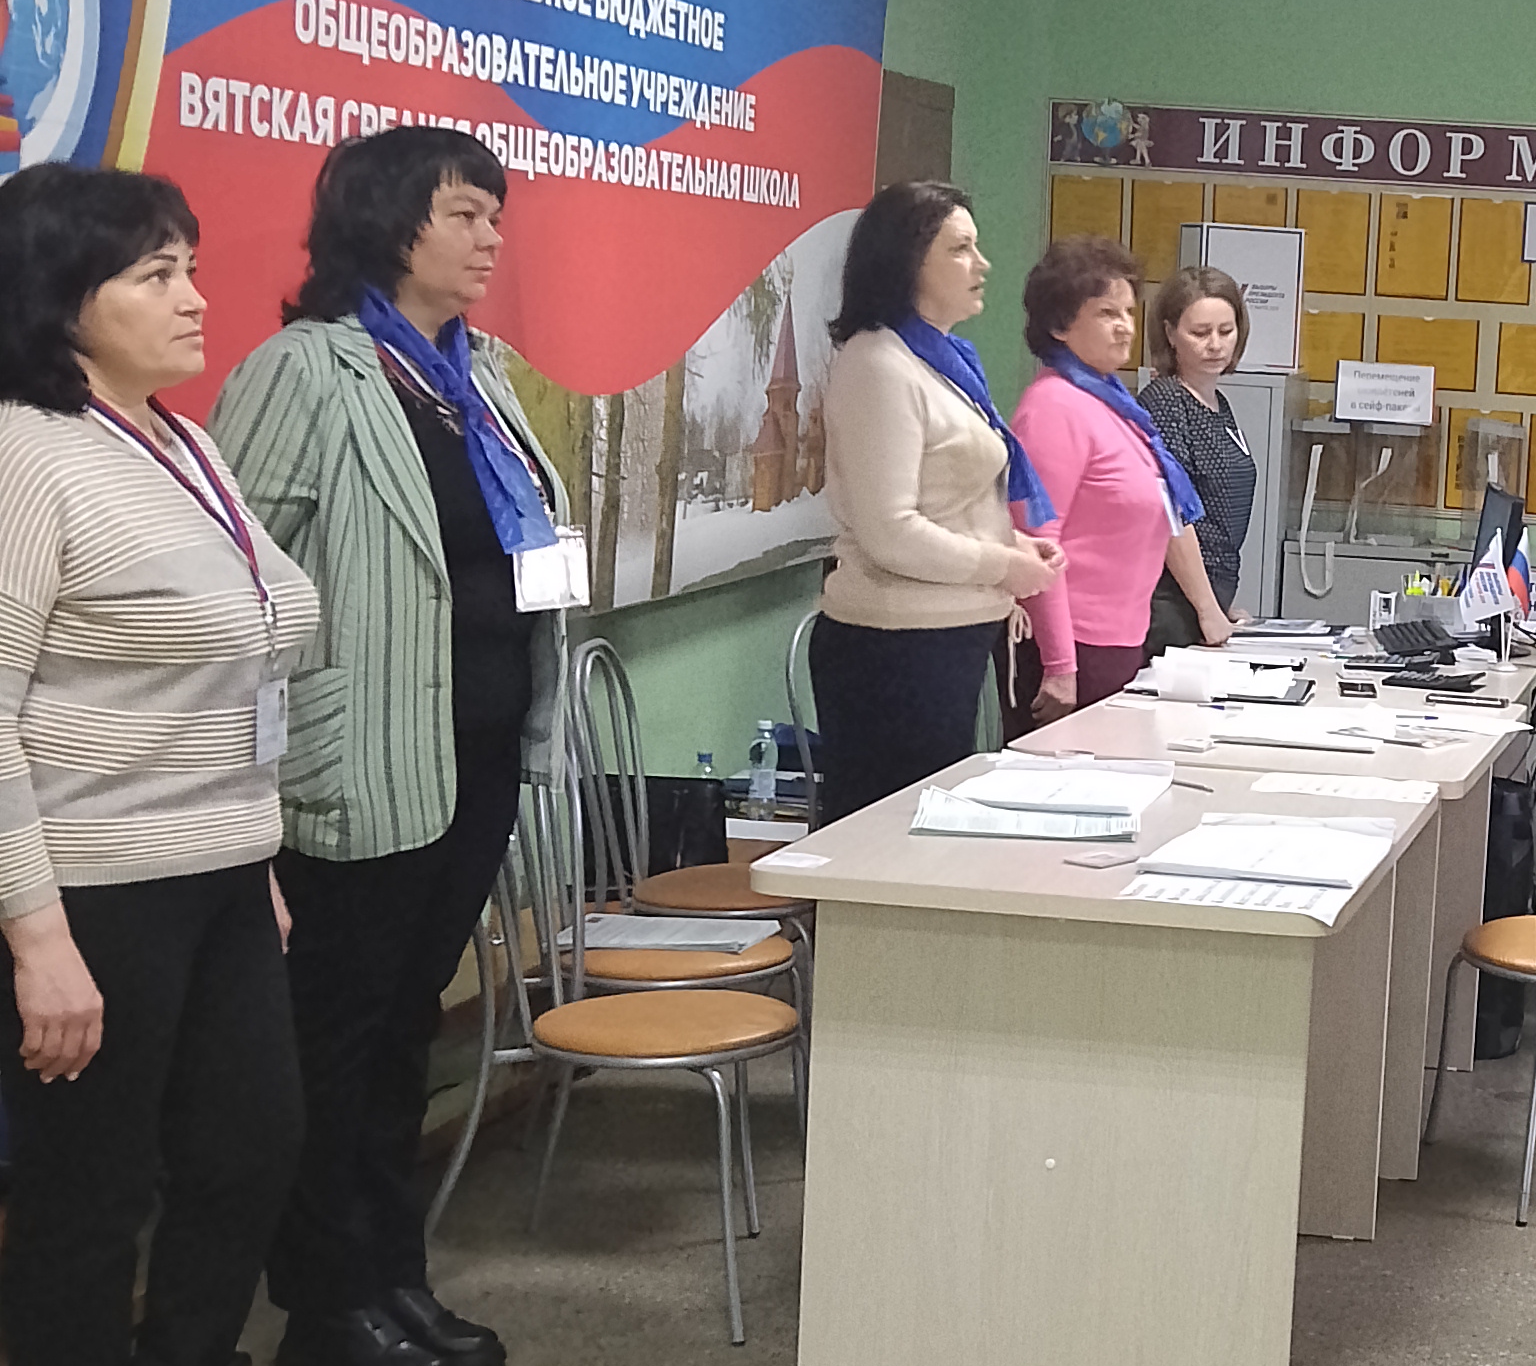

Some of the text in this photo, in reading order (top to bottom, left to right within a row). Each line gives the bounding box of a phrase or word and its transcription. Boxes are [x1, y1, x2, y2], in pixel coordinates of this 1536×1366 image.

[180, 72, 335, 148] ВЯТСКАЯ
[742, 165, 800, 209] ШКОЛА
[629, 66, 756, 132] УЧРЕЖДЕНИЕ
